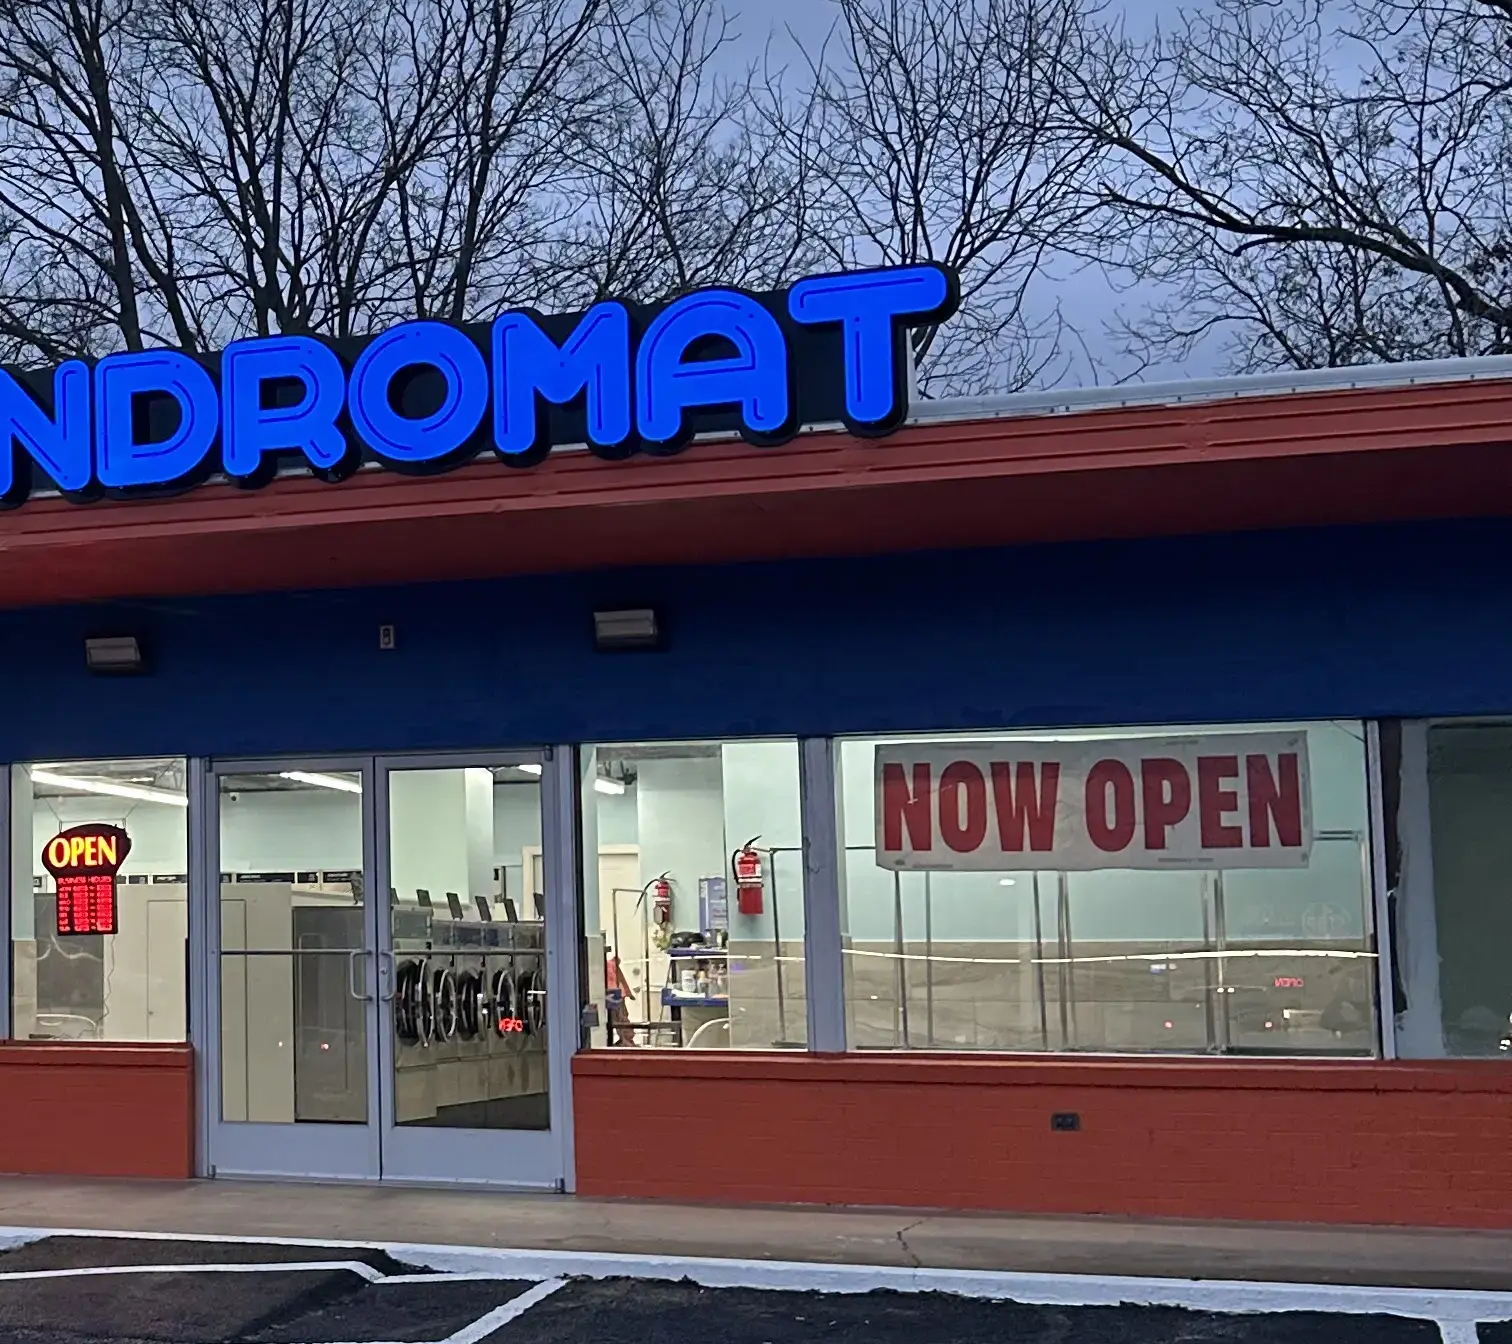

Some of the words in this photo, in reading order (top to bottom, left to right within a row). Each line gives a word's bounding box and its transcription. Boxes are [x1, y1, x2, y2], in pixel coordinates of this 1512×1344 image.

[883, 761, 1061, 853] NOW
[1086, 754, 1302, 852] OPEN
[49, 836, 117, 868] OPEN
